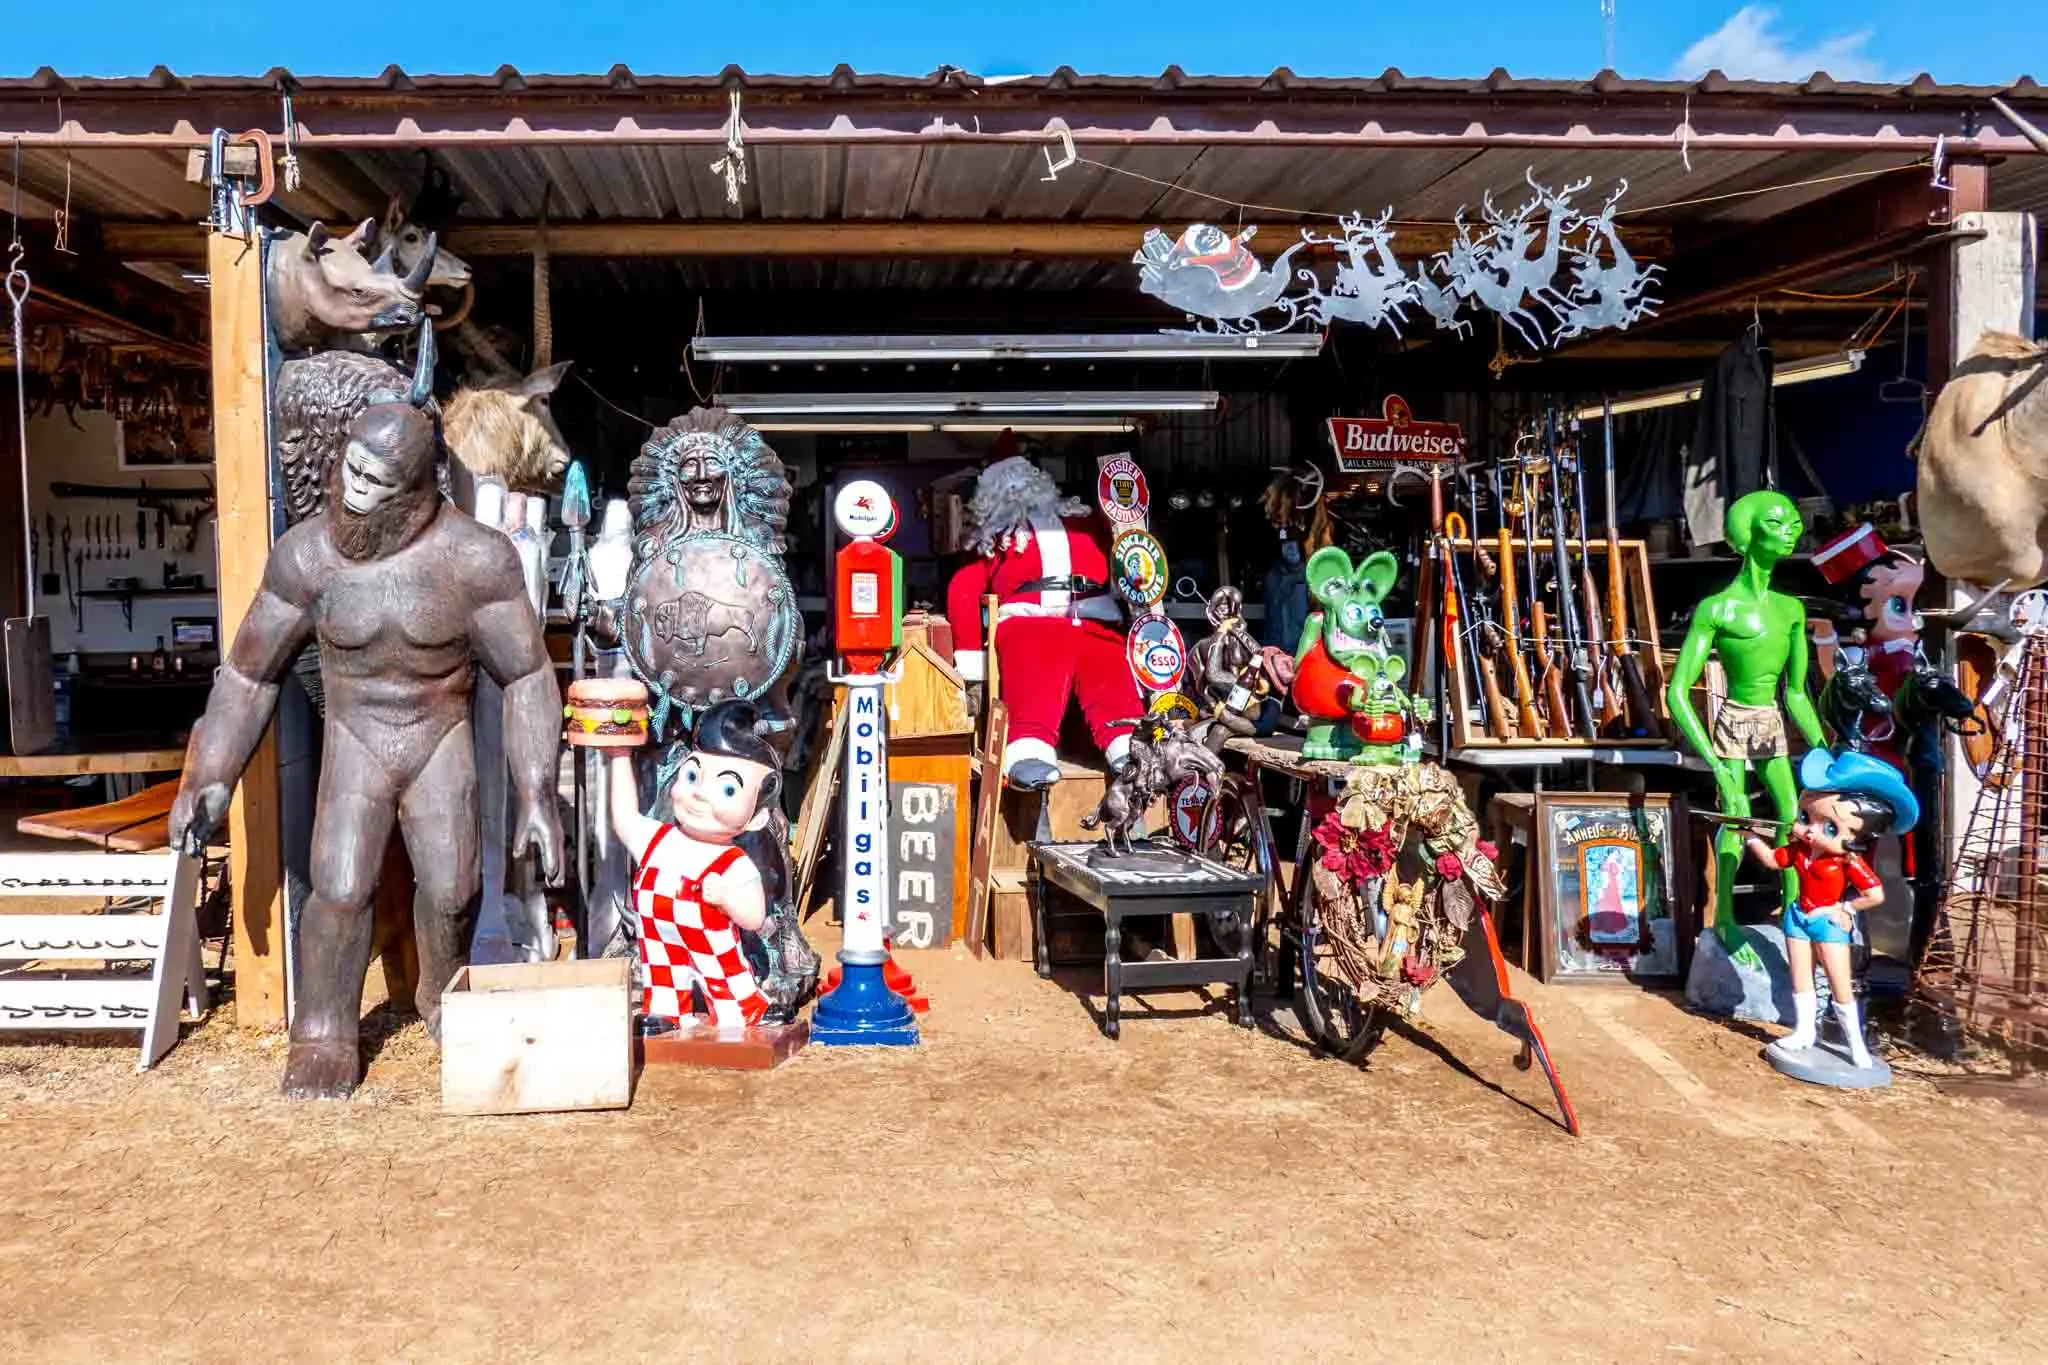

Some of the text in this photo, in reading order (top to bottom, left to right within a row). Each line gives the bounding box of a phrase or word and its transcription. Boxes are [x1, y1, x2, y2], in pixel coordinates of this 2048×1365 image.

[1344, 423, 1464, 454] Budweiser
[1104, 460, 1140, 479] COSDEN
[1105, 499, 1146, 522] GASOLINE
[1115, 534, 1160, 561] SINCLAIR
[1118, 573, 1163, 603] GASOLINE
[855, 696, 873, 903] Mobilgas
[1181, 796, 1205, 806] TEXAC
[897, 787, 940, 948] BEER
